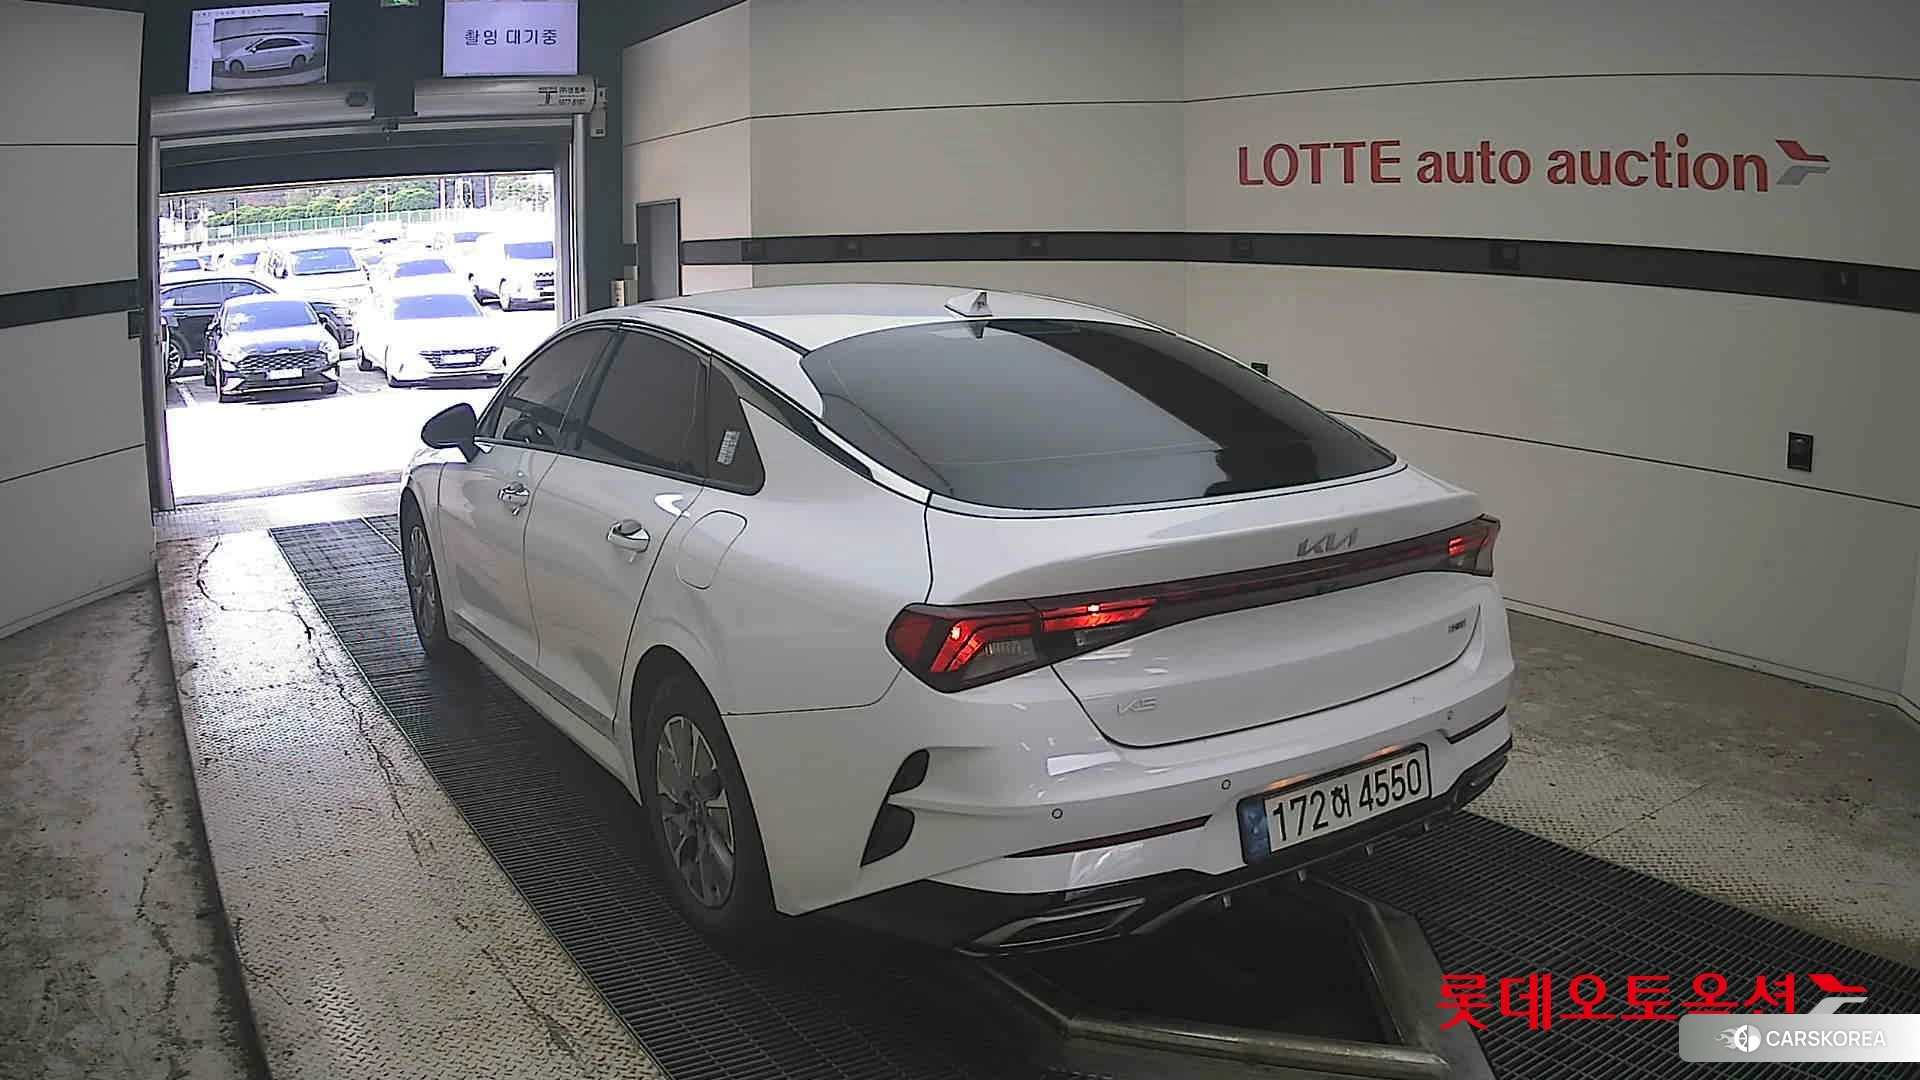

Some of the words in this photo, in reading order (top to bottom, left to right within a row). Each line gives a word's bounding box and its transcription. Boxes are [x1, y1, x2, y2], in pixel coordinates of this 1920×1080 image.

[505, 29, 558, 46] 대기중
[1239, 140, 1401, 187] LOTTE
[1417, 141, 1532, 185] auto
[1547, 134, 1769, 192] auction
[1272, 783, 1352, 842] 172허
[1358, 757, 1422, 812] 4550
